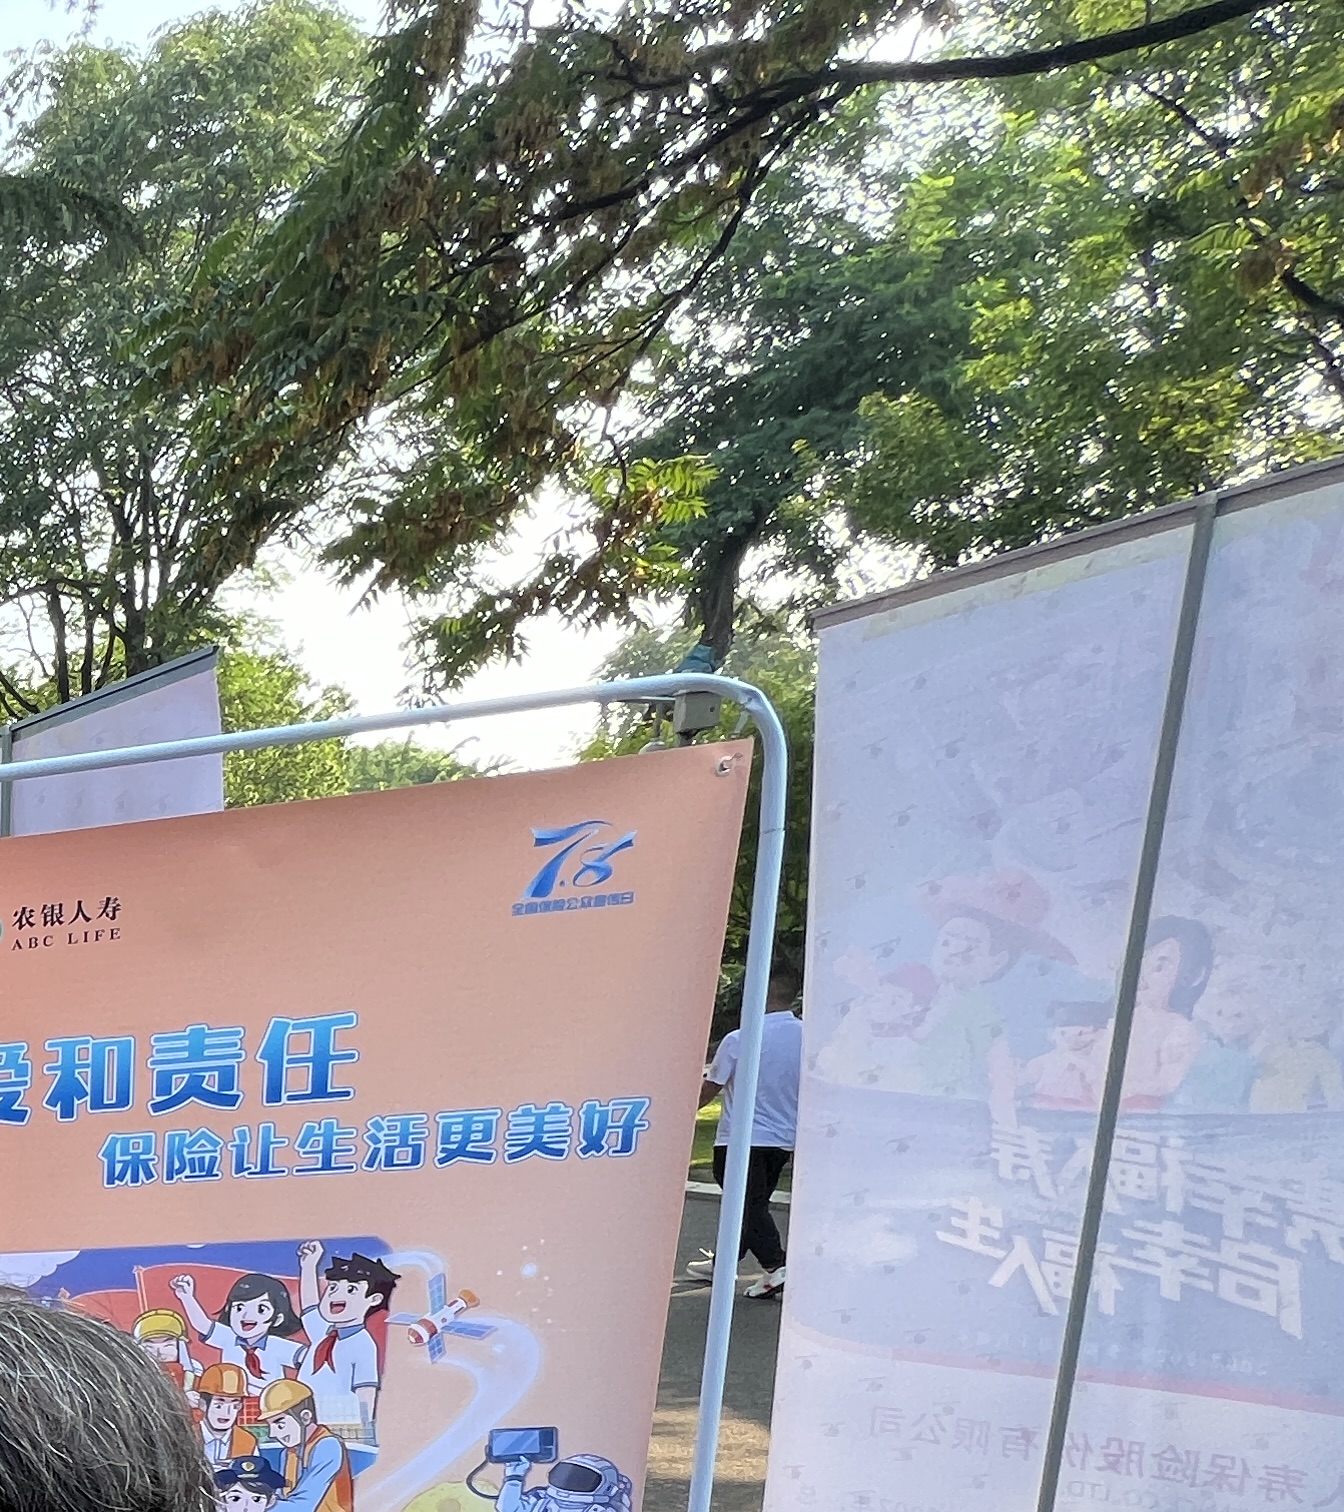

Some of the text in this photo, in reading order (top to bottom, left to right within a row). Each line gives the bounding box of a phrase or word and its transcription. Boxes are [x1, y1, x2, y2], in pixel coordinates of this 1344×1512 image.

[11, 896, 123, 931] 农银人寿
[11, 926, 123, 952] ABC LIFE
[99, 1096, 652, 1189] 保险让生活更美好
